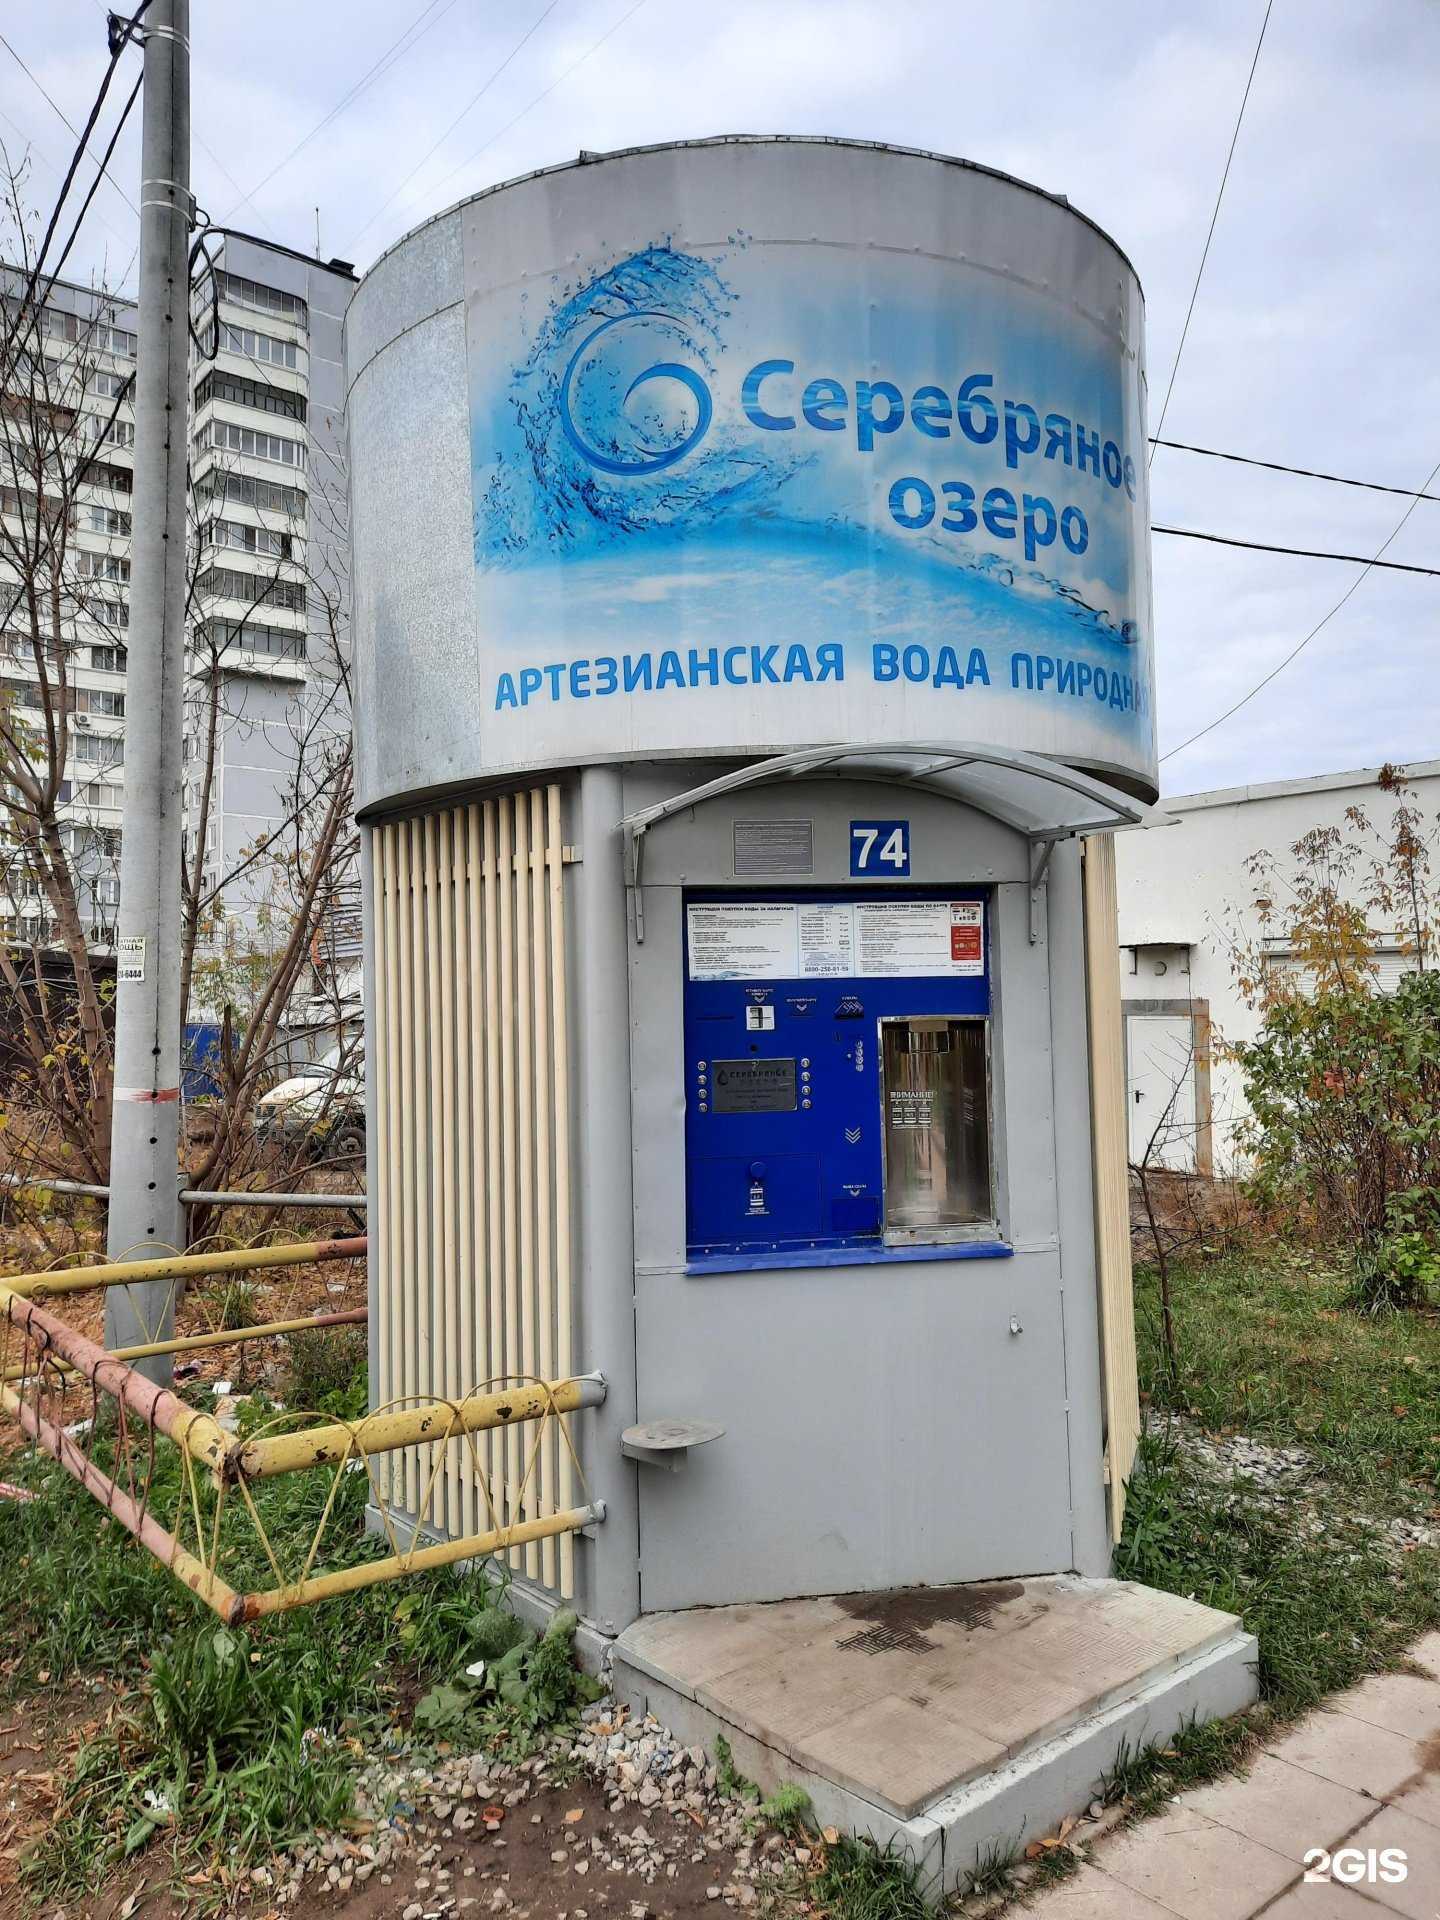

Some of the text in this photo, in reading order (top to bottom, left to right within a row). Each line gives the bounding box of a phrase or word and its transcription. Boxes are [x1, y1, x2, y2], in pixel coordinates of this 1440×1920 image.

[740, 359, 1137, 504] Серебряное
[888, 477, 1089, 561] озеро
[494, 643, 844, 711] АРТЕЗИАНСКАЯ
[873, 643, 991, 690] ВОДА
[853, 828, 907, 868] 74
